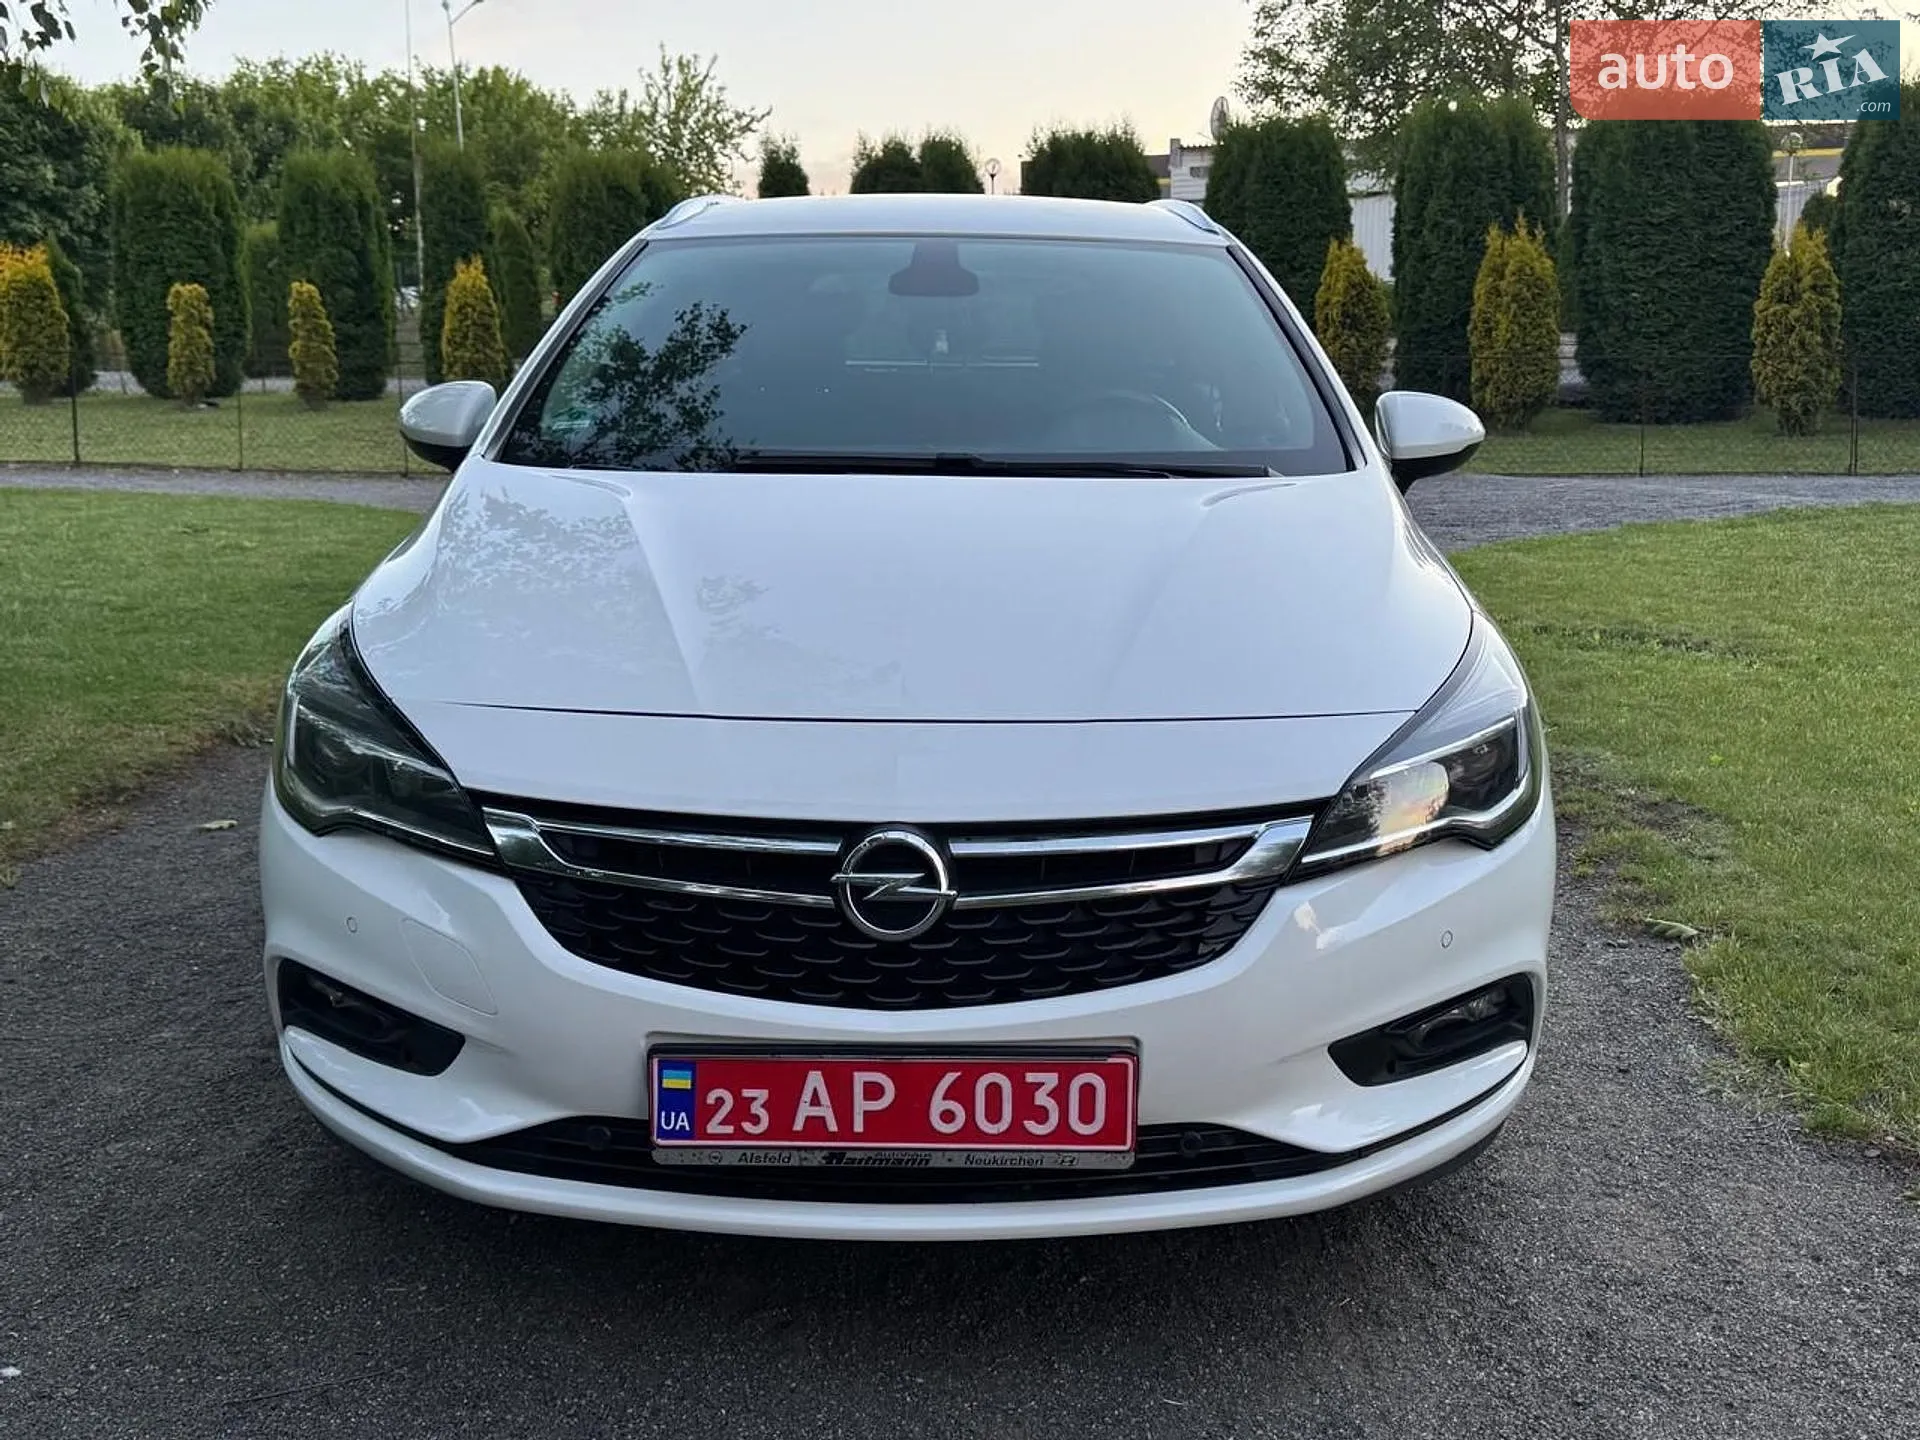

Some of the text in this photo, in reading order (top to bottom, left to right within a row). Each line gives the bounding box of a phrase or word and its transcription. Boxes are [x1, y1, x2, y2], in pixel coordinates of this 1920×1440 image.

[705, 1070, 1106, 1135] 23 AP 6030
[661, 1111, 691, 1131] UA
[738, 1151, 792, 1164] Alsfeld
[964, 1153, 1045, 1166] Neukirchen
